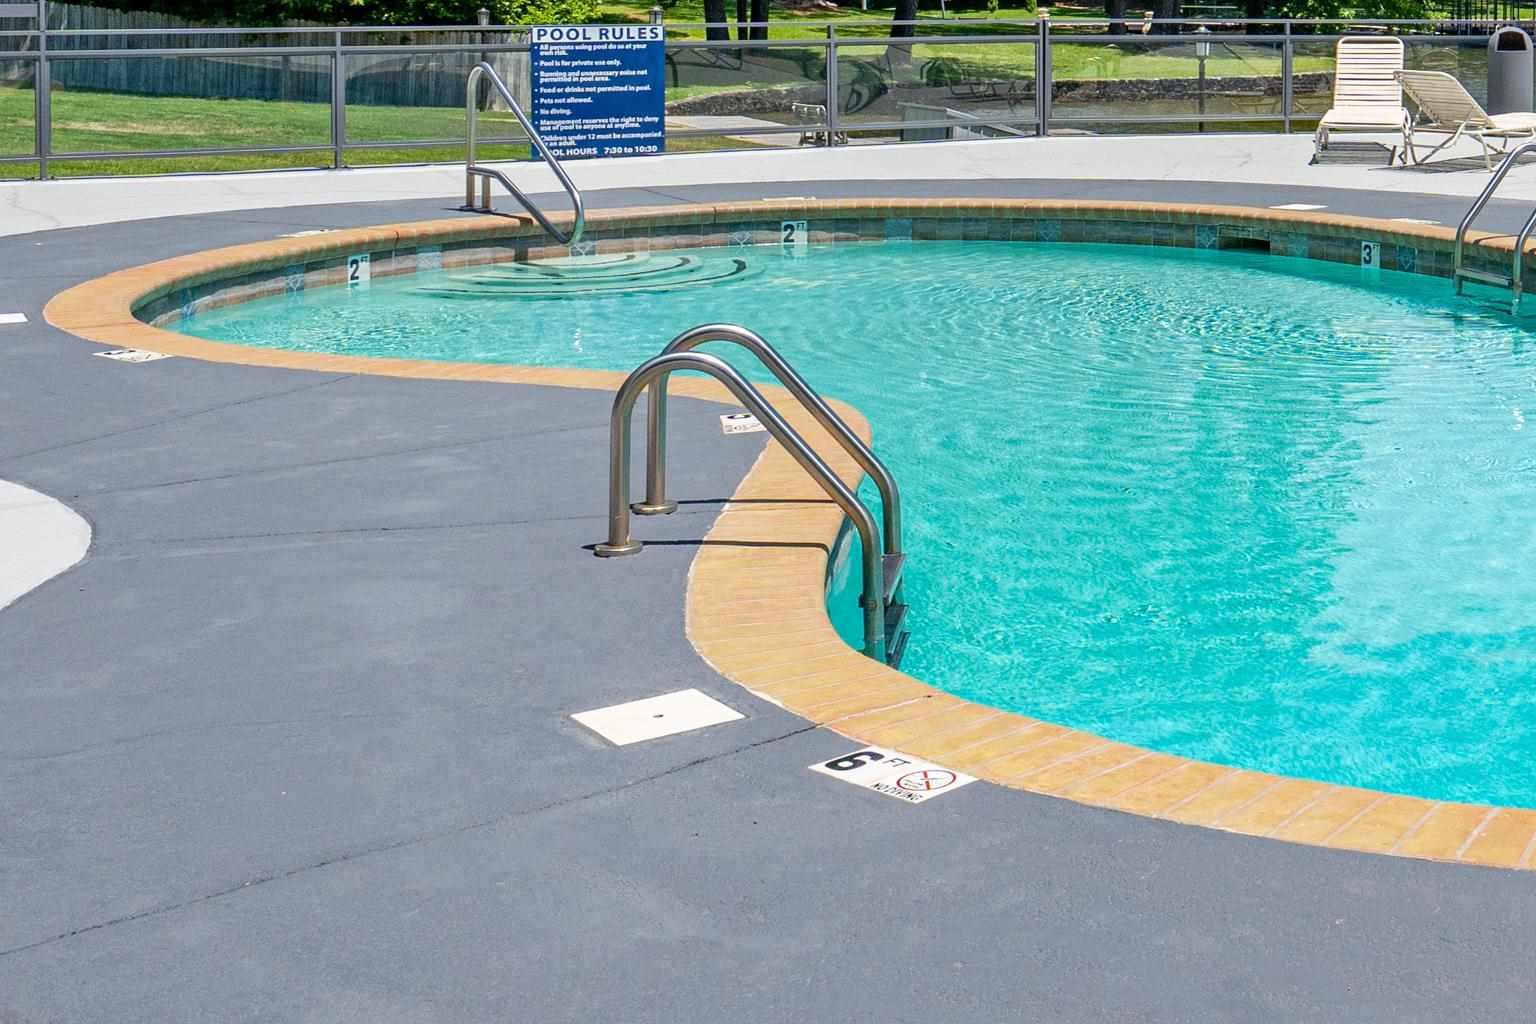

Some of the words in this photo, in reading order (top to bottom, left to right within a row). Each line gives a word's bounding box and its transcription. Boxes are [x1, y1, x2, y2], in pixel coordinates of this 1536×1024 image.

[537, 28, 591, 40] POOL
[600, 28, 659, 39] RULES
[576, 44, 592, 52] using
[572, 60, 593, 68] private
[566, 148, 598, 156] HOURS
[604, 147, 623, 155] 7:30
[635, 145, 658, 153] 10:30
[783, 224, 795, 243] 2
[1364, 244, 1372, 265] 3
[351, 259, 360, 281] 2
[825, 751, 885, 771] 6
[882, 758, 912, 768] FT
[872, 782, 886, 791] NO
[886, 787, 924, 801] DIVING
